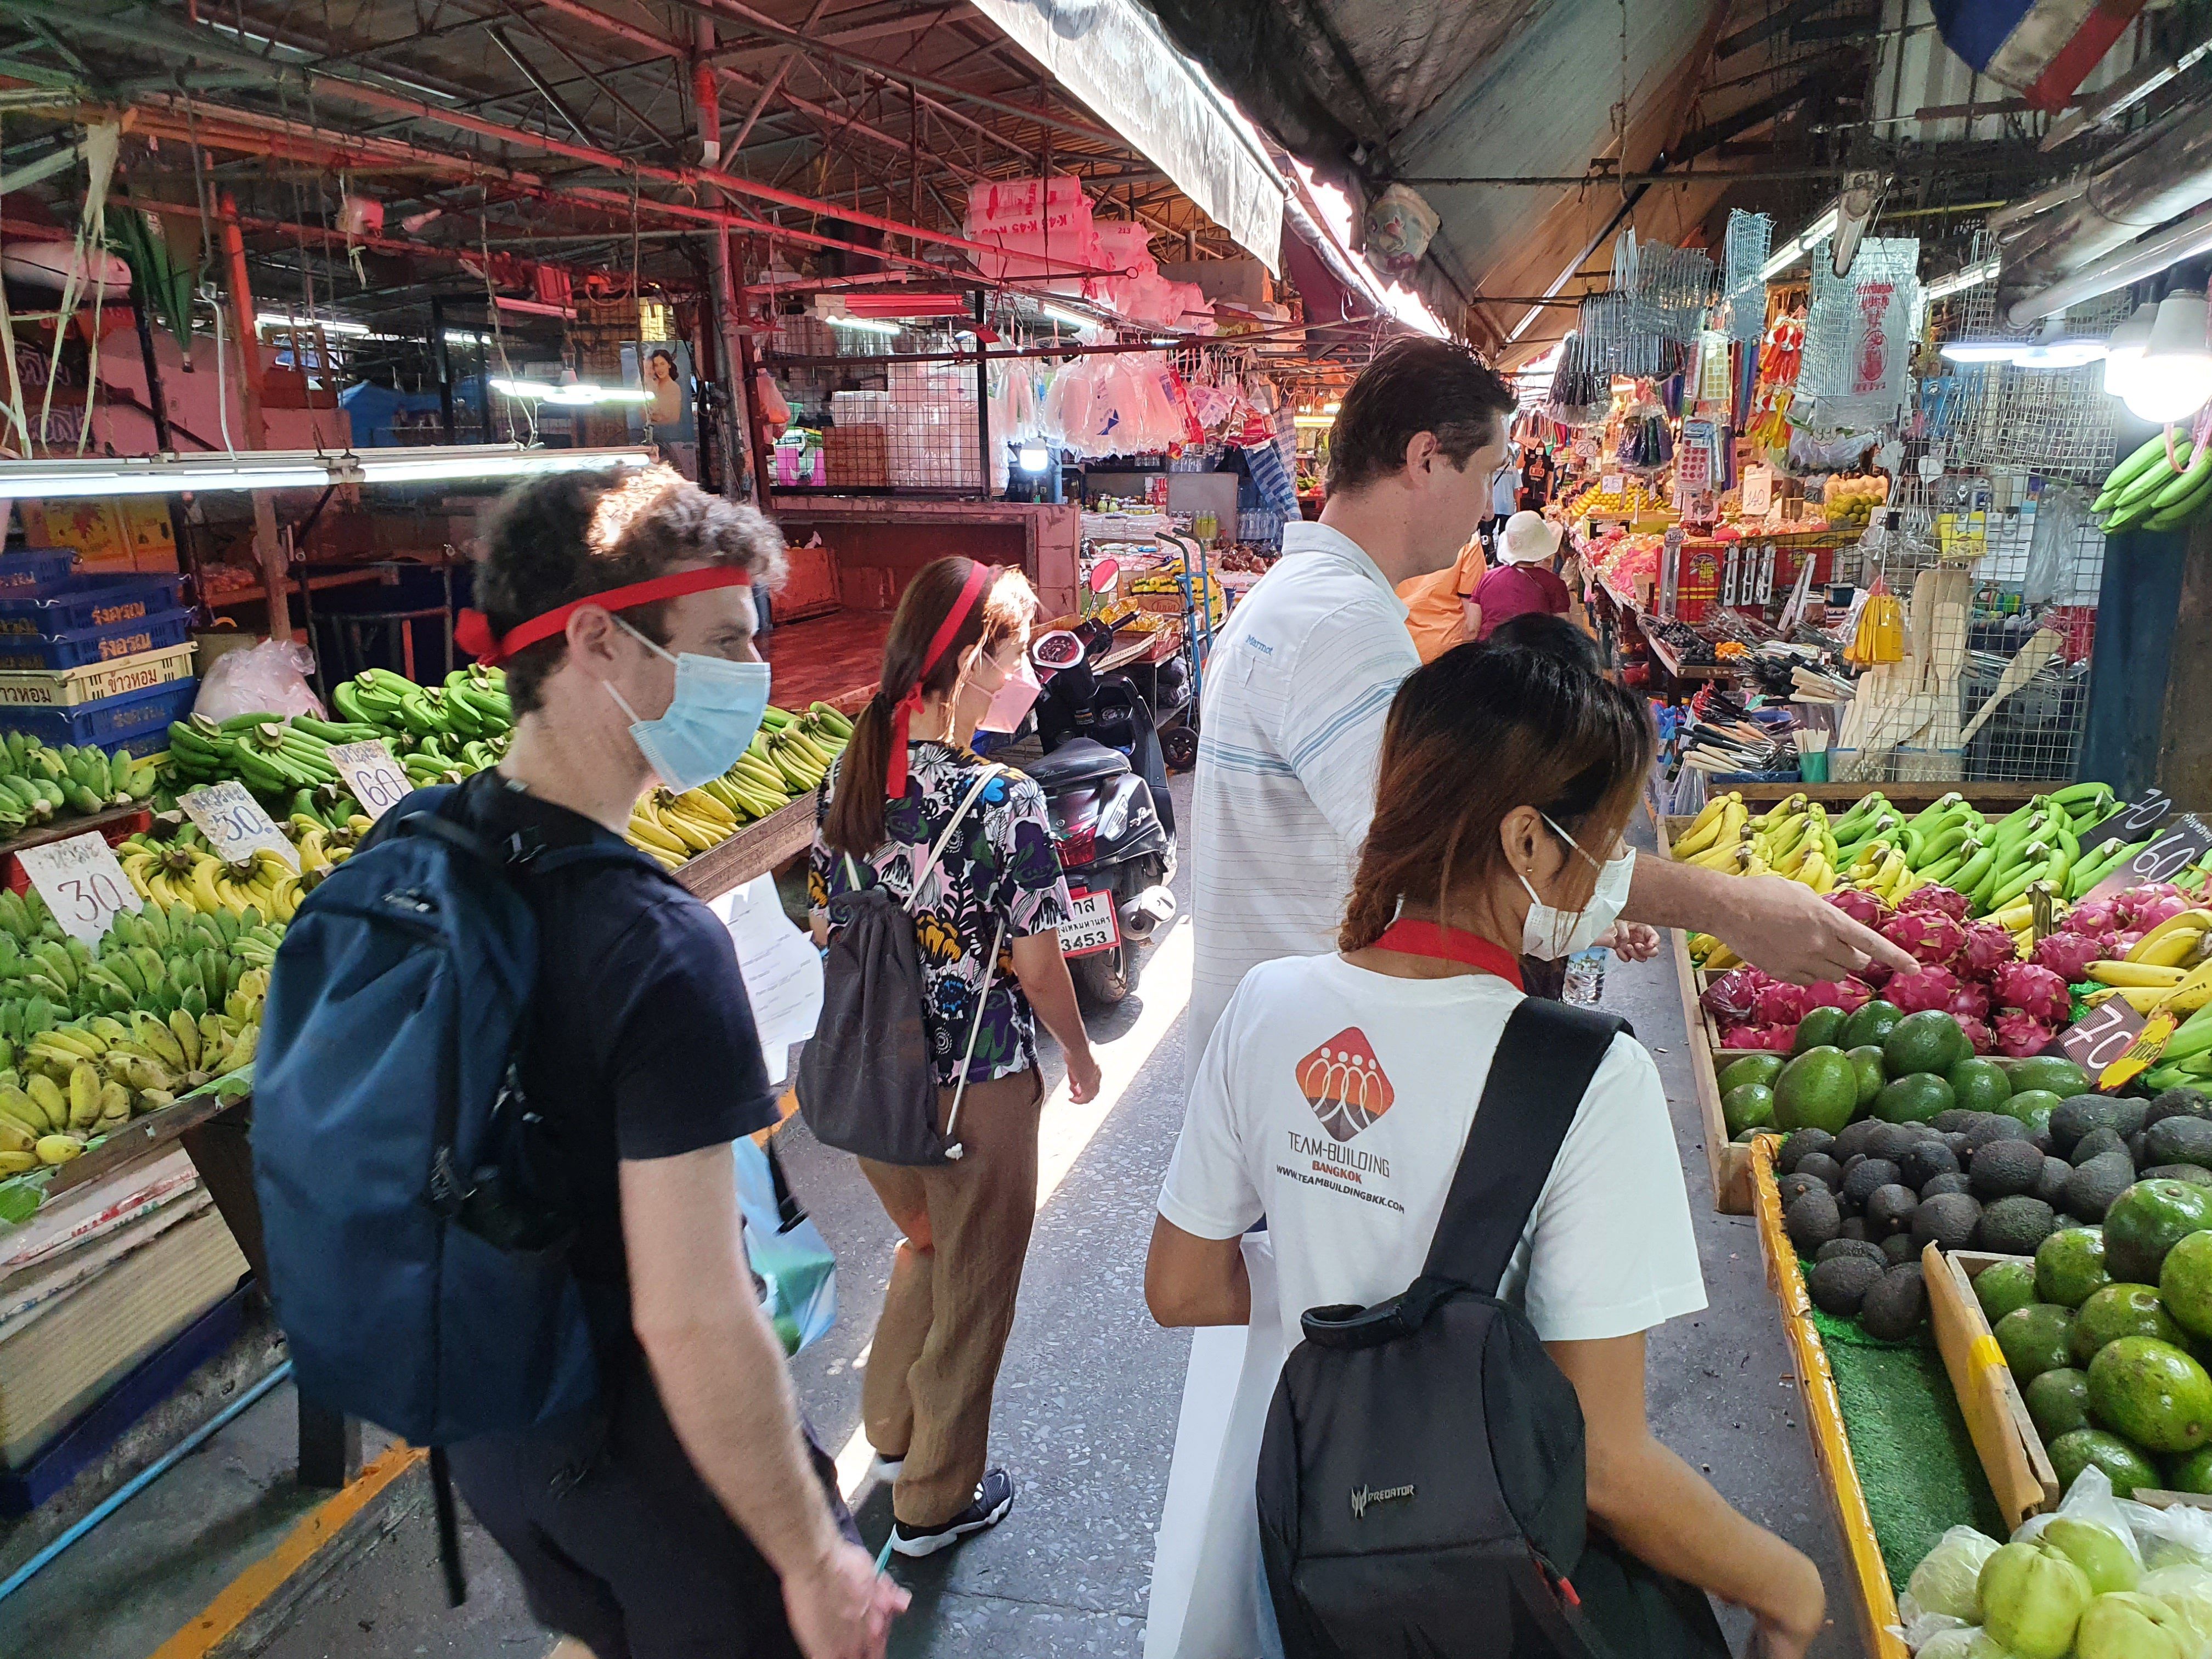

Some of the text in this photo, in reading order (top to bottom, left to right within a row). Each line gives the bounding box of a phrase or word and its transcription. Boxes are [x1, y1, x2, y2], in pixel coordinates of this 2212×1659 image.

[1118, 226, 1131, 234] 213
[1745, 489, 1765, 507] 140
[108, 667, 158, 693] ข้าวหอม
[0, 686, 52, 703] าวหอม
[356, 768, 404, 806] 60
[2112, 788, 2171, 830] 70
[2132, 832, 2195, 883] 60
[57, 873, 123, 922] 30
[1060, 930, 1107, 952] 3453
[1288, 1131, 1390, 1178] TEAM-BUILDING
[1311, 1160, 1363, 1184] BANGKOK
[1276, 1164, 1406, 1215] WWW.TEAMBUILDINGBKK.COM
[1368, 1484, 1414, 1502] PREDATOR
